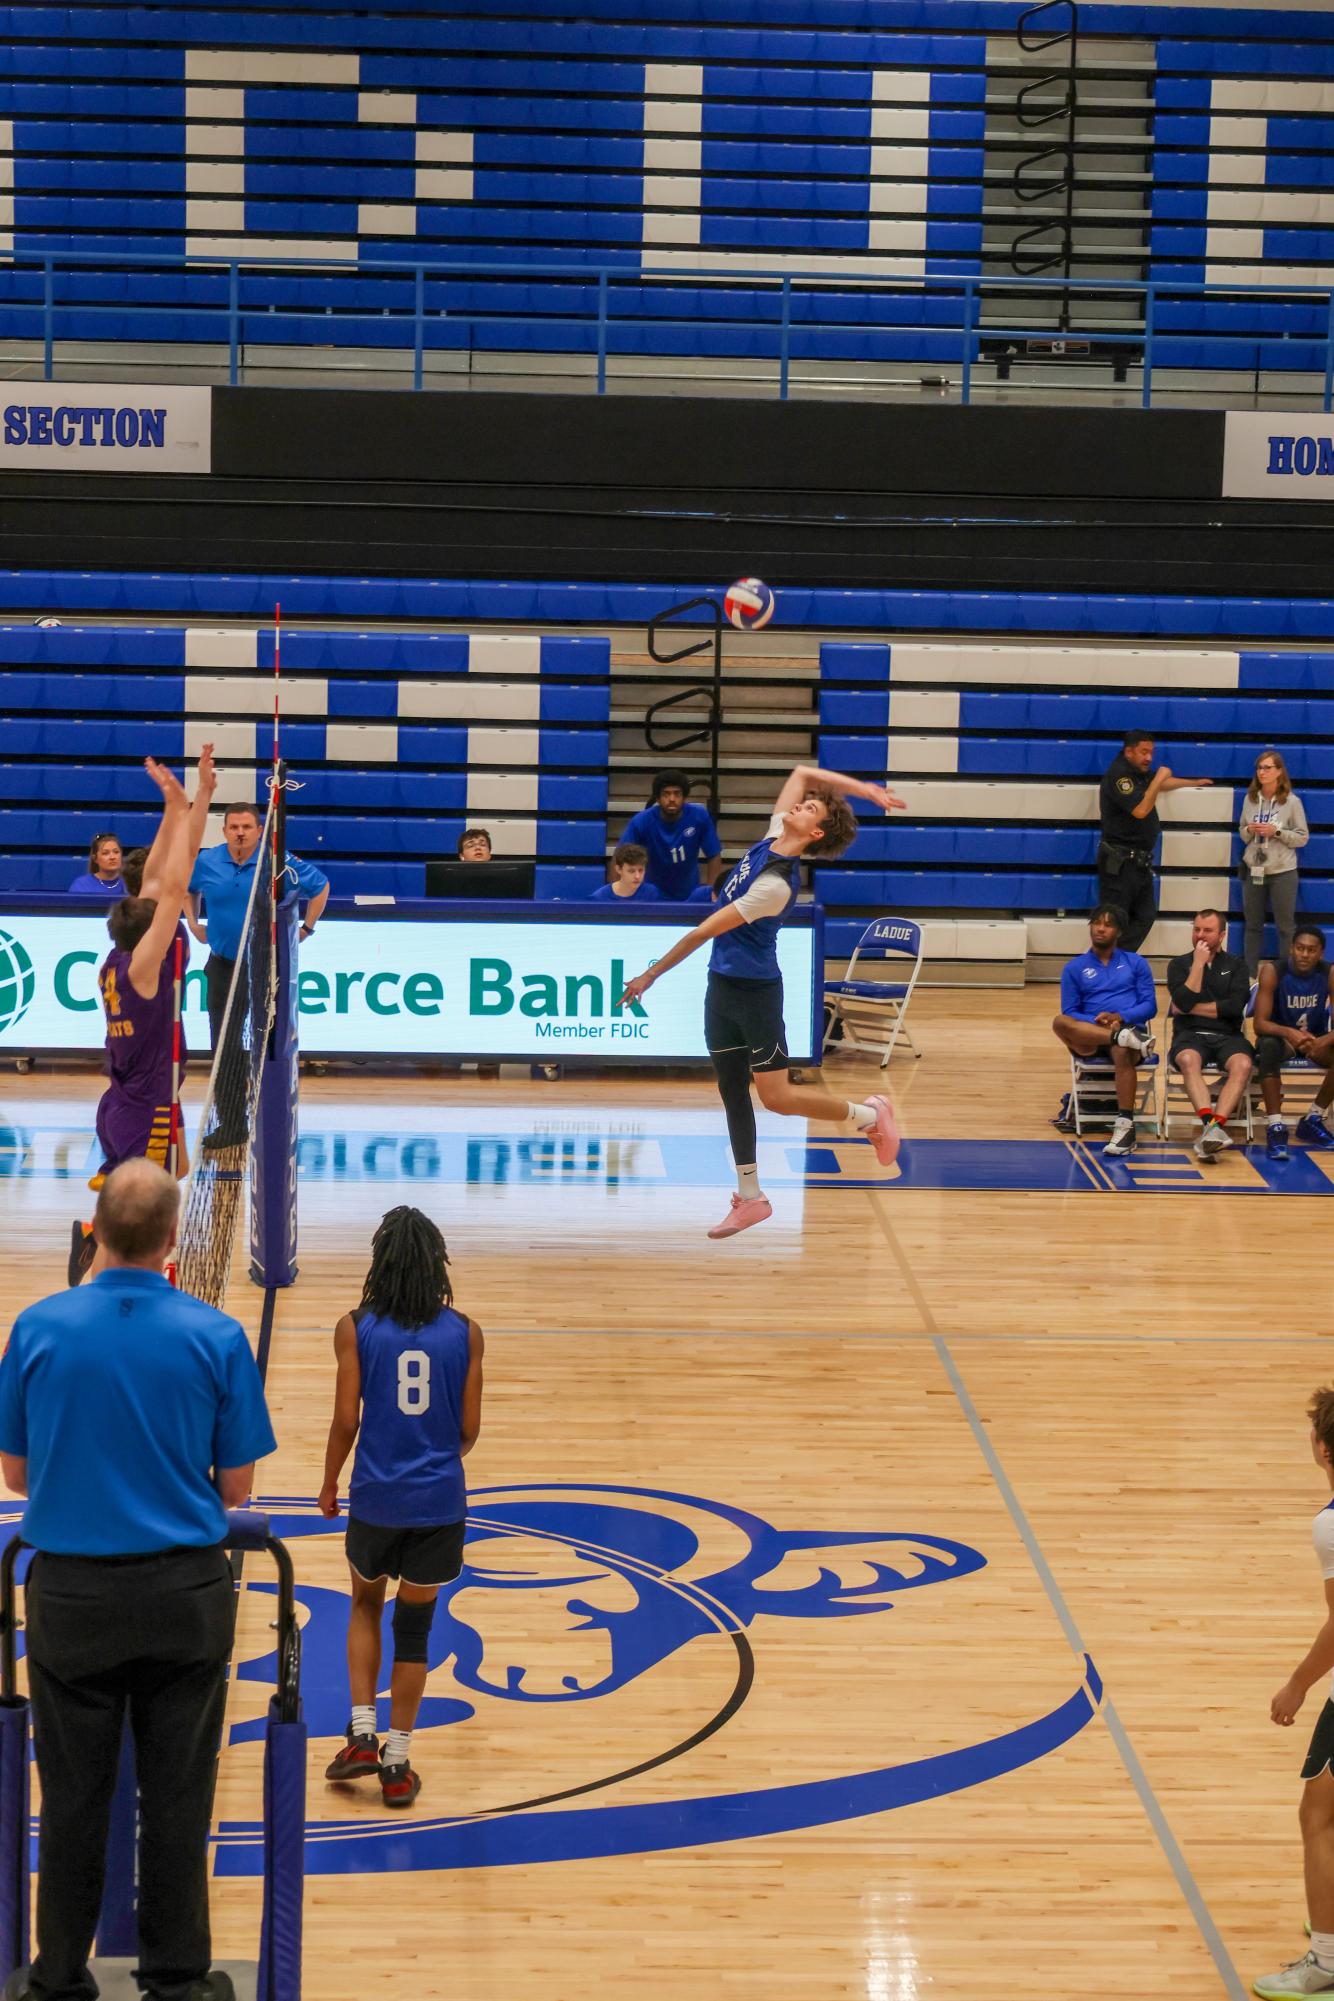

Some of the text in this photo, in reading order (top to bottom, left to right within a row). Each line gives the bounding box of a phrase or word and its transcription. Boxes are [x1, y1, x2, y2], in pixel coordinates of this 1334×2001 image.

[4, 406, 167, 448] SECTION
[670, 845, 685, 864] 11
[873, 925, 914, 941] LADUE
[53, 950, 649, 1018] Cerce Bank
[1287, 994, 1318, 1009] LADUE
[535, 1022, 649, 1039] Member FDIC
[1296, 1013, 1308, 1032] 4
[397, 1350, 431, 1416] 8
